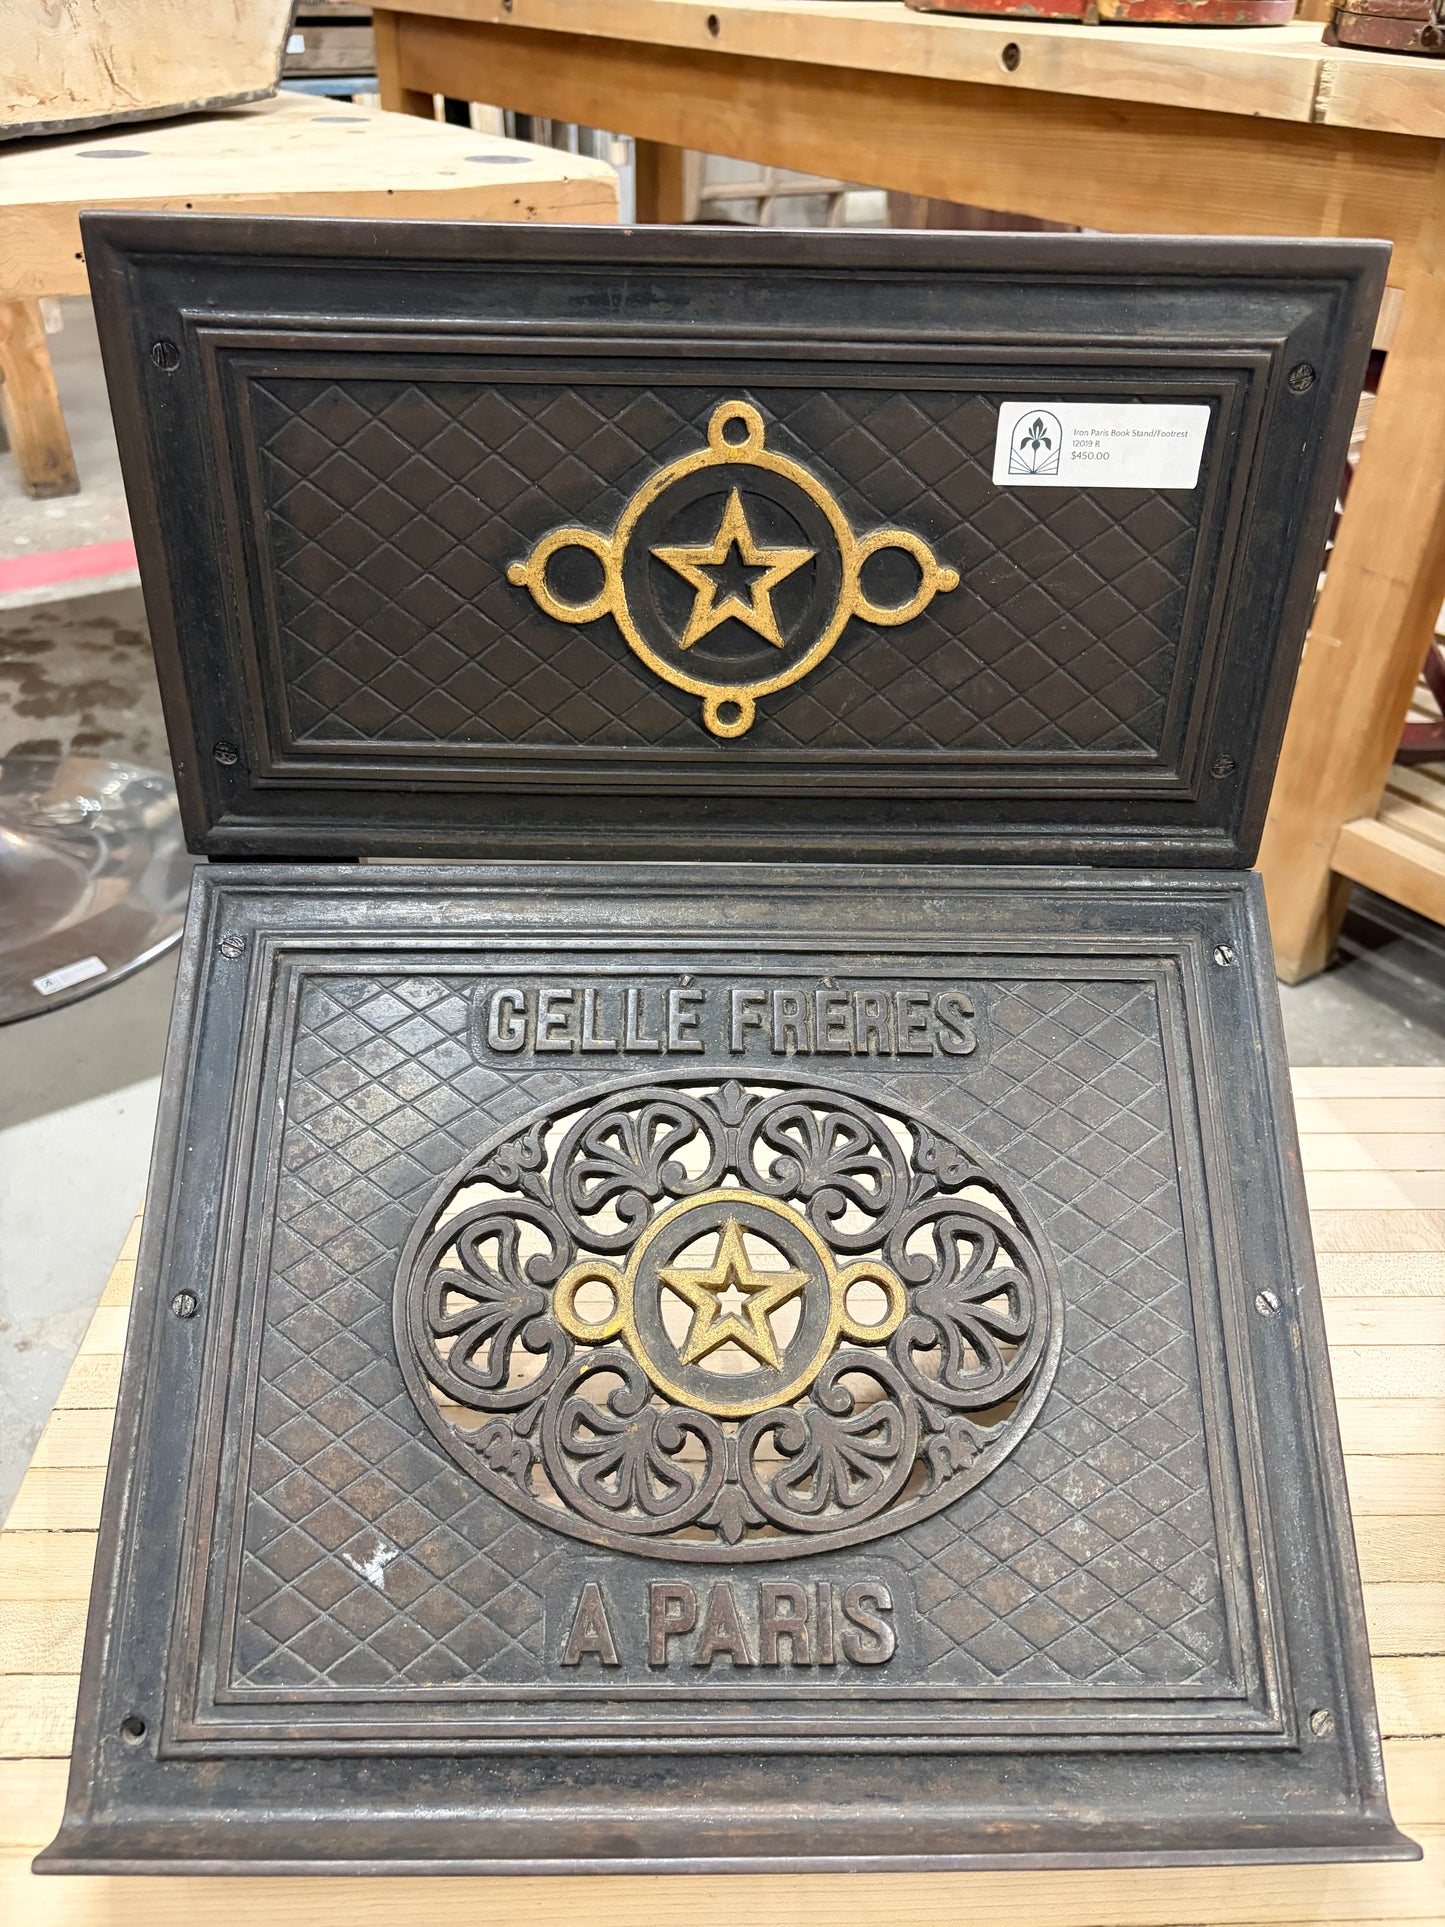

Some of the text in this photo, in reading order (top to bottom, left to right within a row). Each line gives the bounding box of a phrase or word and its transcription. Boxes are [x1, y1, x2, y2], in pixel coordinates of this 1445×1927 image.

[1073, 428, 1188, 438] Iron Paris Book Stand/Footrest
[1072, 439, 1101, 448] 12019 R
[1071, 450, 1110, 461] $450.00
[486, 974, 978, 1056] GELLÉ FRÈRES
[559, 1580, 897, 1667] A PARIS
